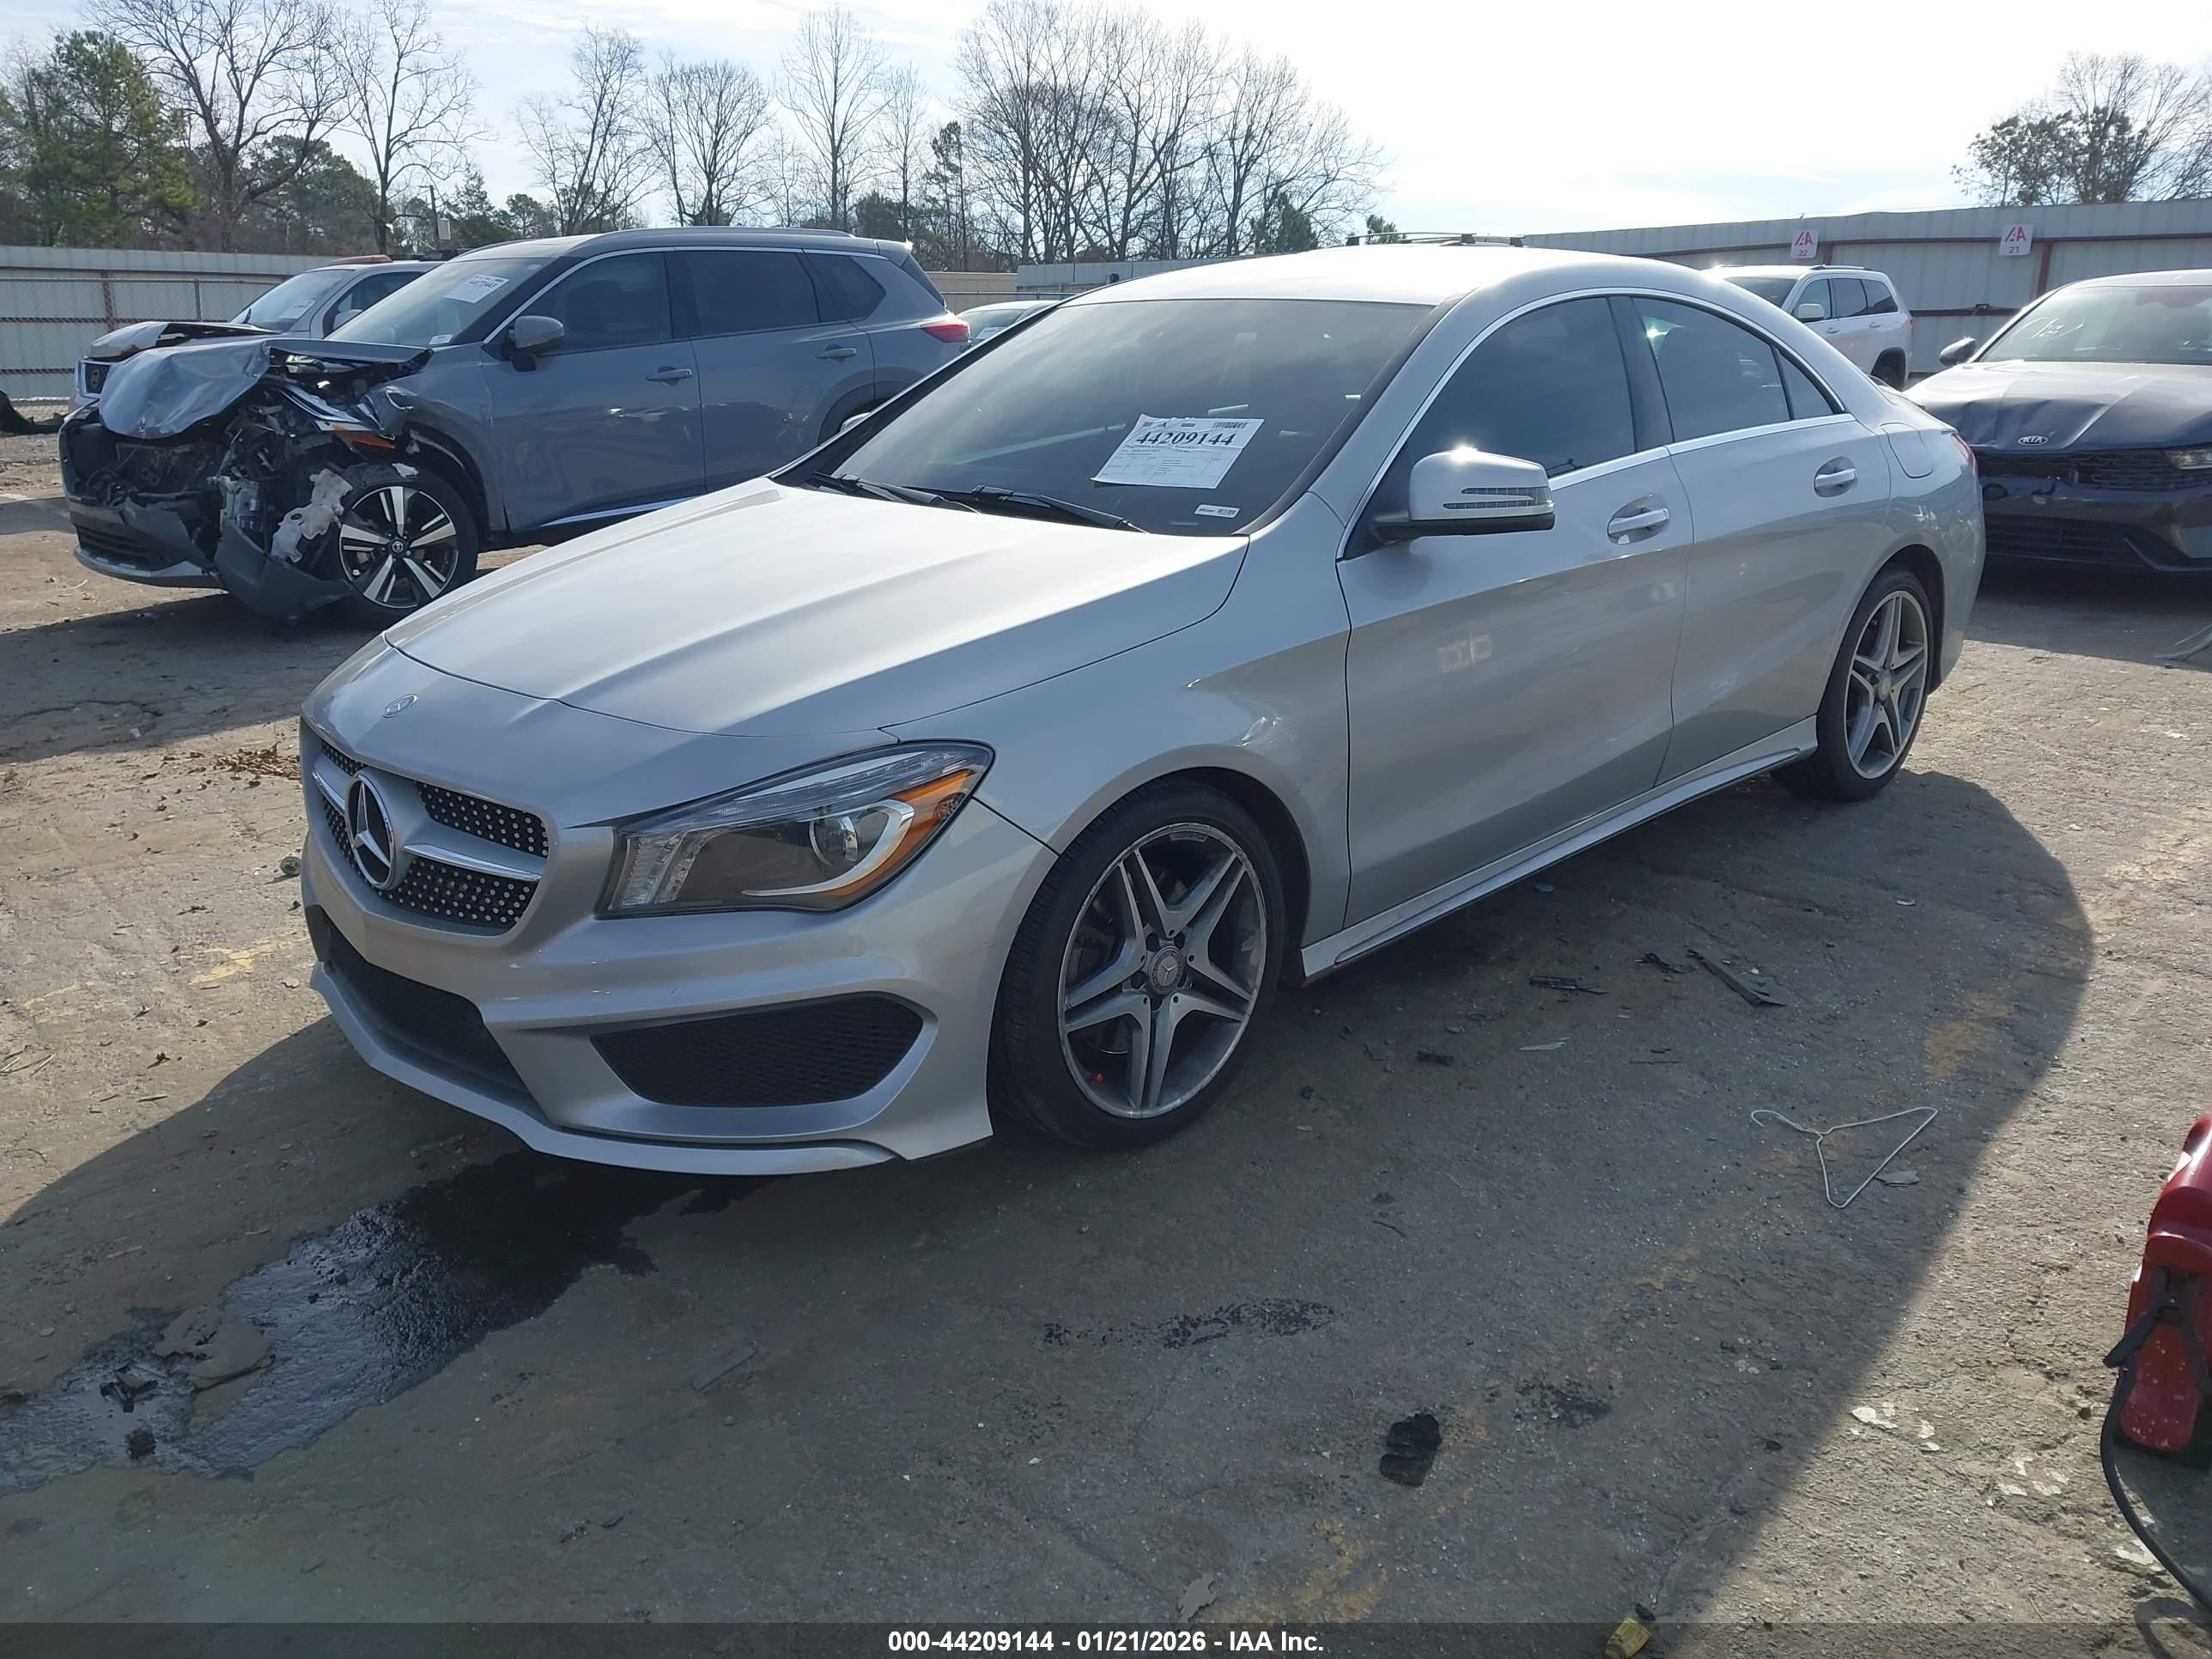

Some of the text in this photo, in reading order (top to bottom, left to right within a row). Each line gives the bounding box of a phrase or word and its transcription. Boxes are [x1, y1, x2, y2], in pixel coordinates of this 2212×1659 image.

[2008, 246, 2020, 254] 21
[1135, 431, 1237, 446] 44209144
[2022, 435, 2043, 444] KIA
